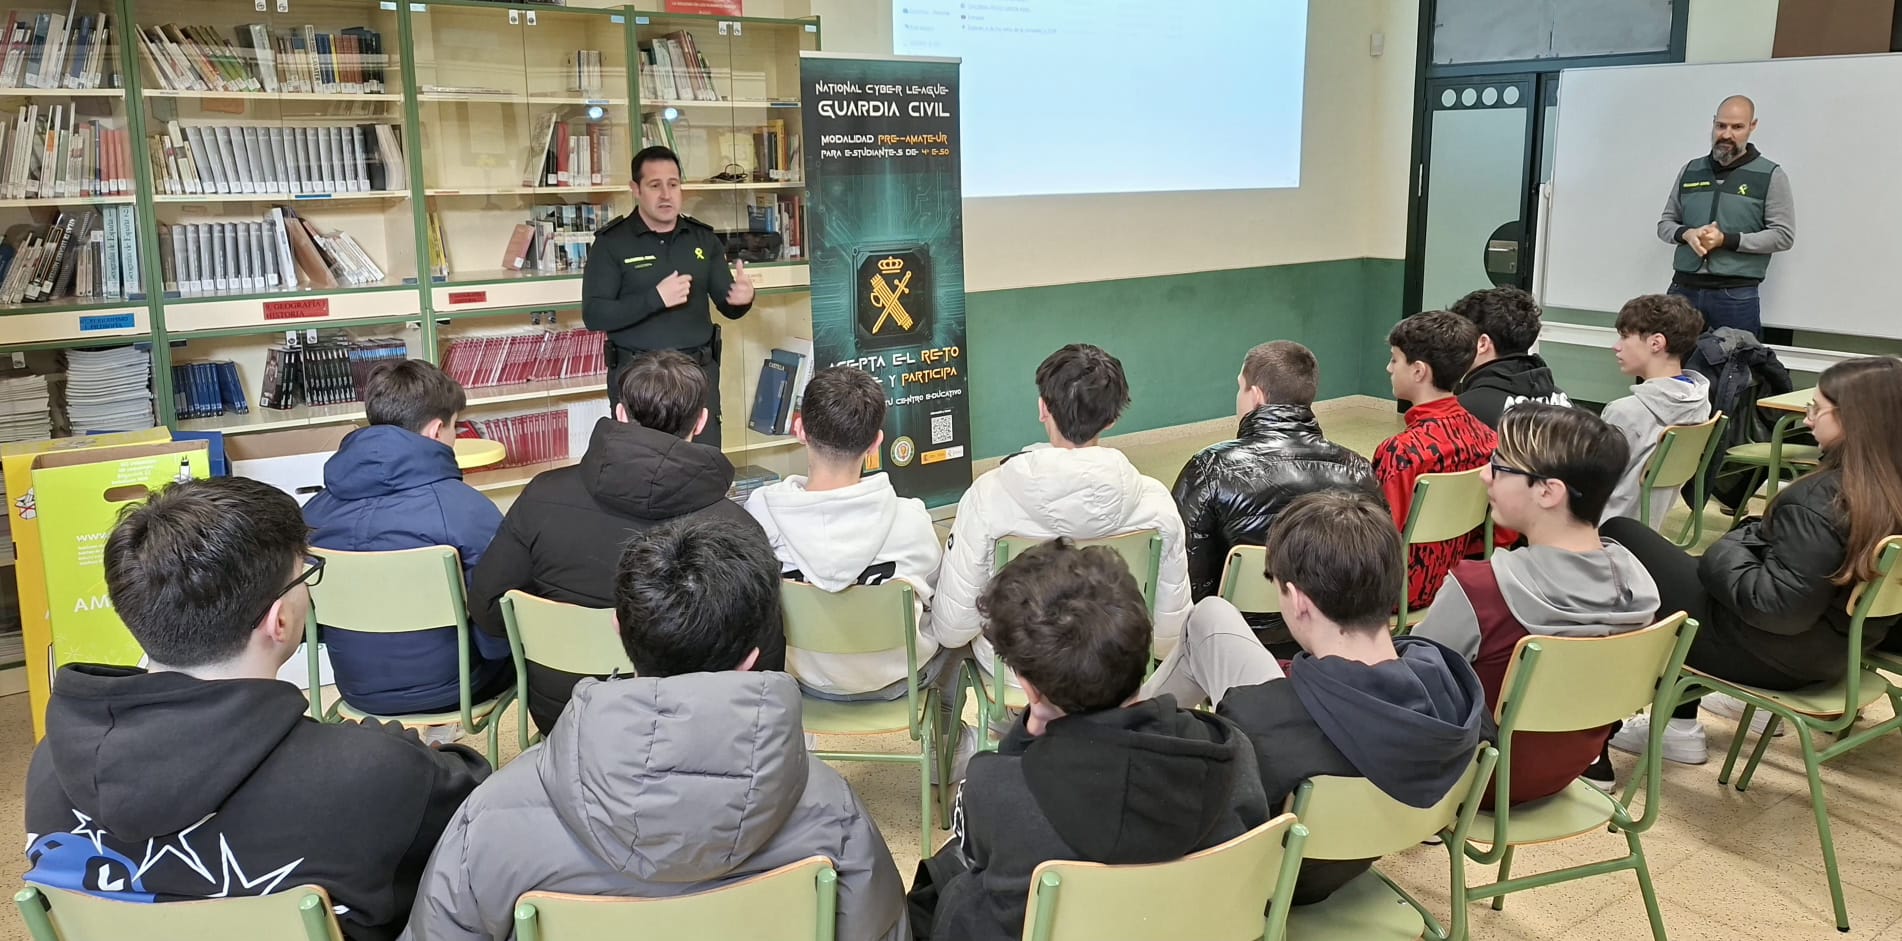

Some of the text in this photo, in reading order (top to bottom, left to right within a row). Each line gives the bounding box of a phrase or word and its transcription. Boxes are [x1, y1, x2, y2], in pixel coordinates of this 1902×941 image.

[816, 80, 949, 98] NATIONAL CYBER LEAGUE
[818, 100, 950, 118] GUARDIA CIVIL
[821, 134, 874, 146] MODALIDAD
[821, 149, 842, 159] PARA
[844, 146, 903, 158] ESTUDIANTES
[892, 352, 915, 366] EL
[921, 346, 959, 364] RETO
[888, 375, 896, 388] Y
[902, 367, 958, 386] PARTICIPA
